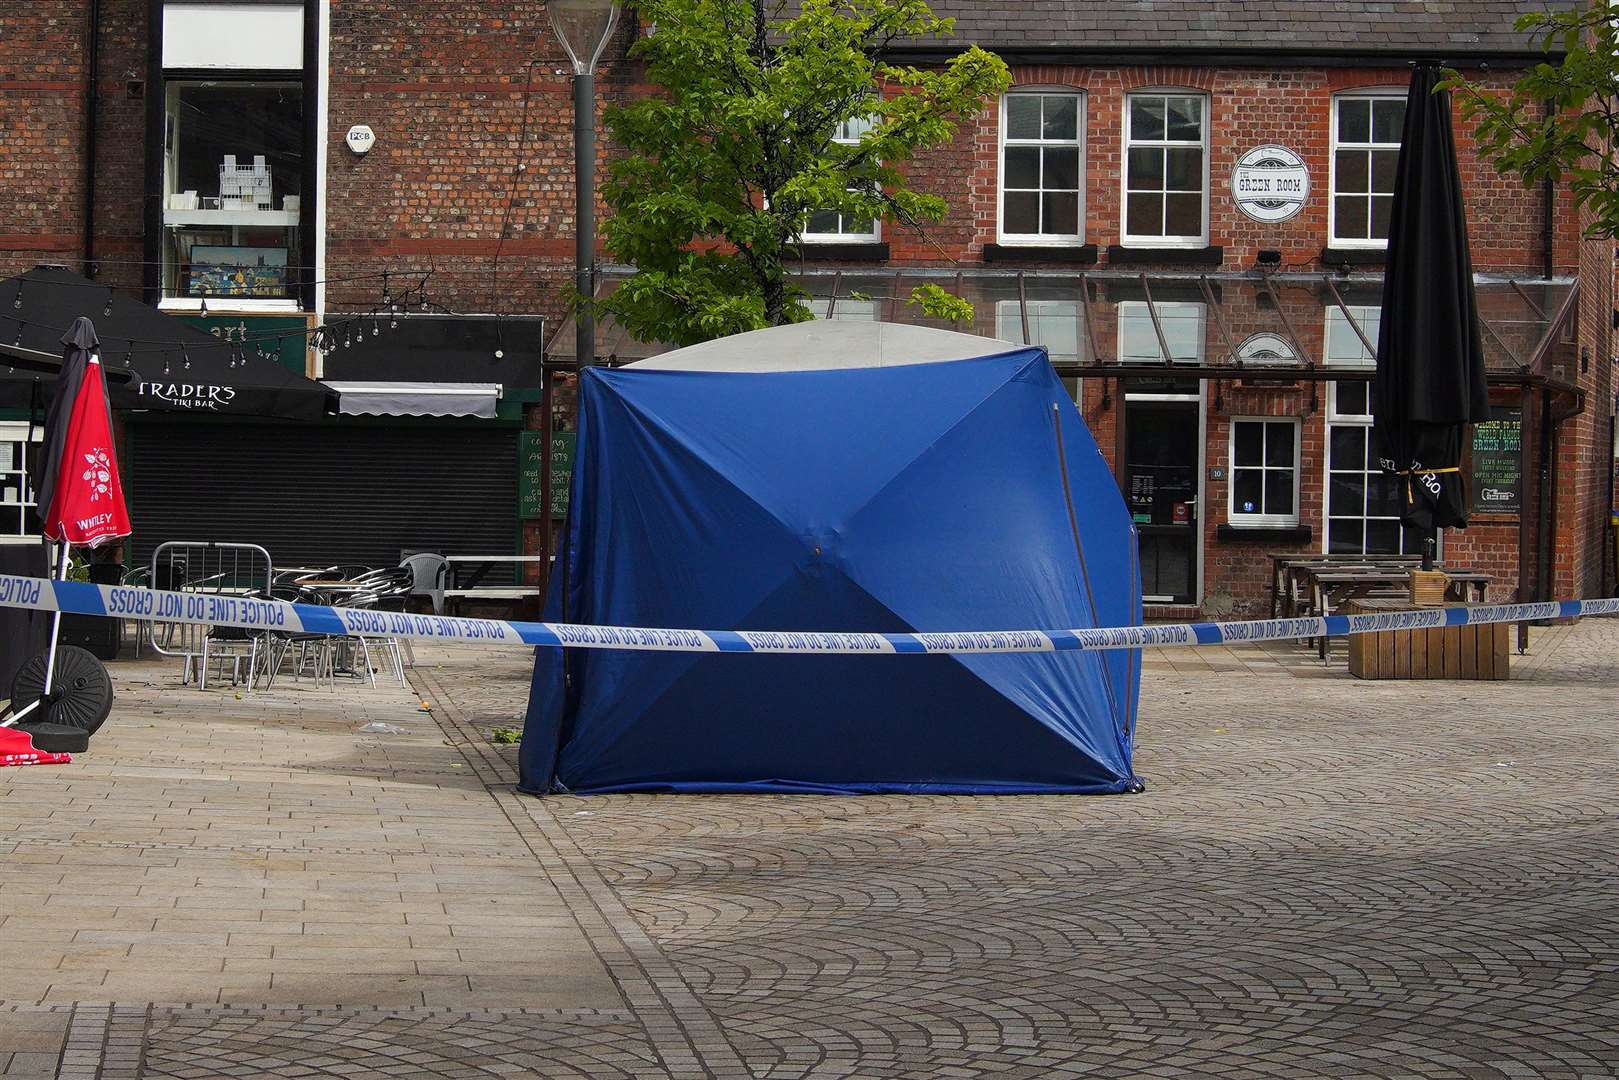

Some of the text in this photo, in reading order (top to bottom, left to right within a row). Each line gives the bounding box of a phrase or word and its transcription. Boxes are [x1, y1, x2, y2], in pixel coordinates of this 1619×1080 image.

[1239, 179, 1301, 191] GREEN ROOM
[210, 320, 247, 341] art
[173, 399, 218, 410] TIKI BAR
[1473, 439, 1499, 450] GREEN
[109, 589, 284, 625] POLICE LINE DO NOT CROSS
[345, 610, 505, 639] POLICE LINE DO NOT CROSS
[1224, 619, 1320, 640] POLICE LINE DO NOT CROSS
[1351, 611, 1440, 631] POLICE LINE DO NOT CROSS
[556, 625, 702, 647] POLICE LINE DO NOT CROSS
[747, 632, 881, 649] POLICE LINE DO NOT CROSS
[920, 632, 1041, 650] POLICE LINE DO NOT CROSS
[1080, 626, 1188, 647] POLICE LINE DO NOT CROSS
